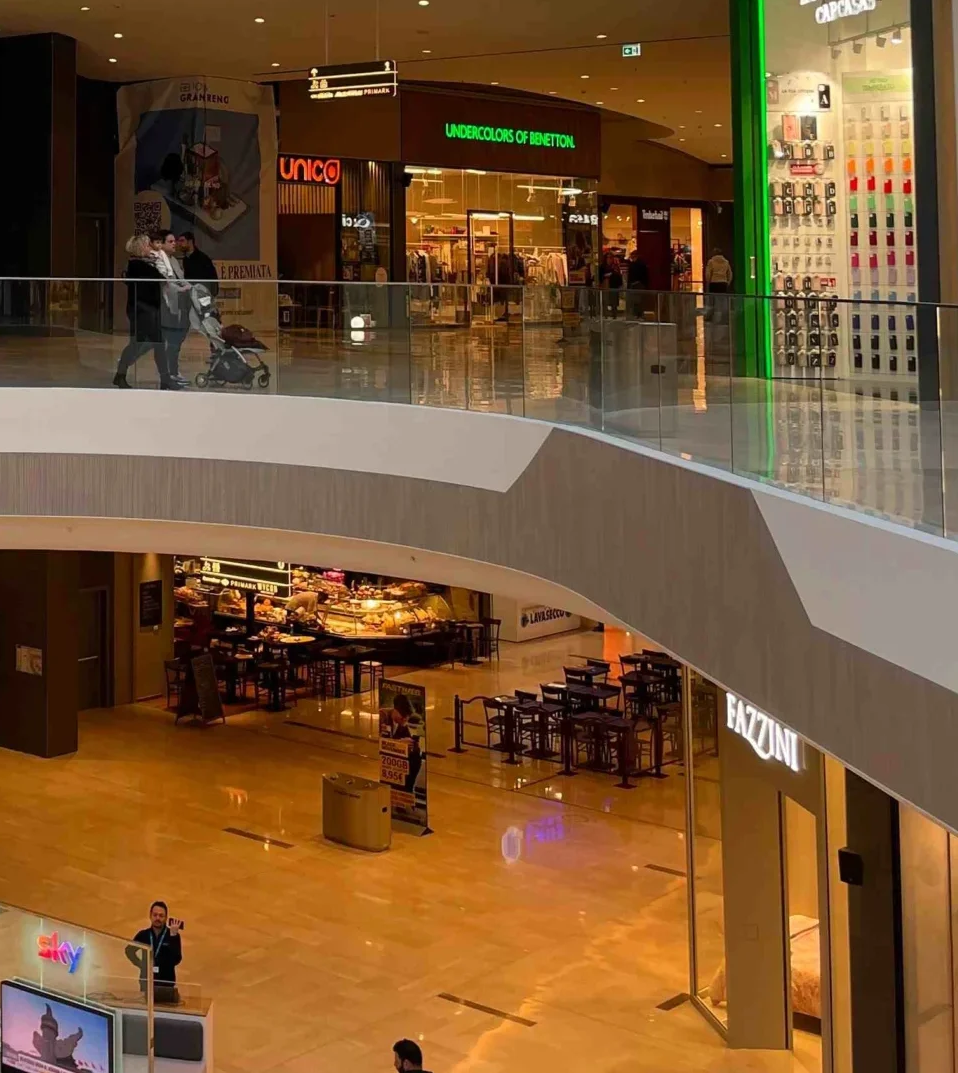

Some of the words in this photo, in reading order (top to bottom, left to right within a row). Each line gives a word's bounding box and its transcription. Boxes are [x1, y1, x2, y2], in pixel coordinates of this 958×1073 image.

[363, 88, 391, 96] PRIMARK
[446, 123, 514, 143] UNDERCOLORS
[516, 130, 528, 144] OF
[228, 264, 272, 279] PREMIATA
[230, 580, 257, 590] PRIMARK
[726, 692, 799, 772] FAZZINI
[381, 756, 408, 770] 200GB
[36, 931, 84, 974] sky
